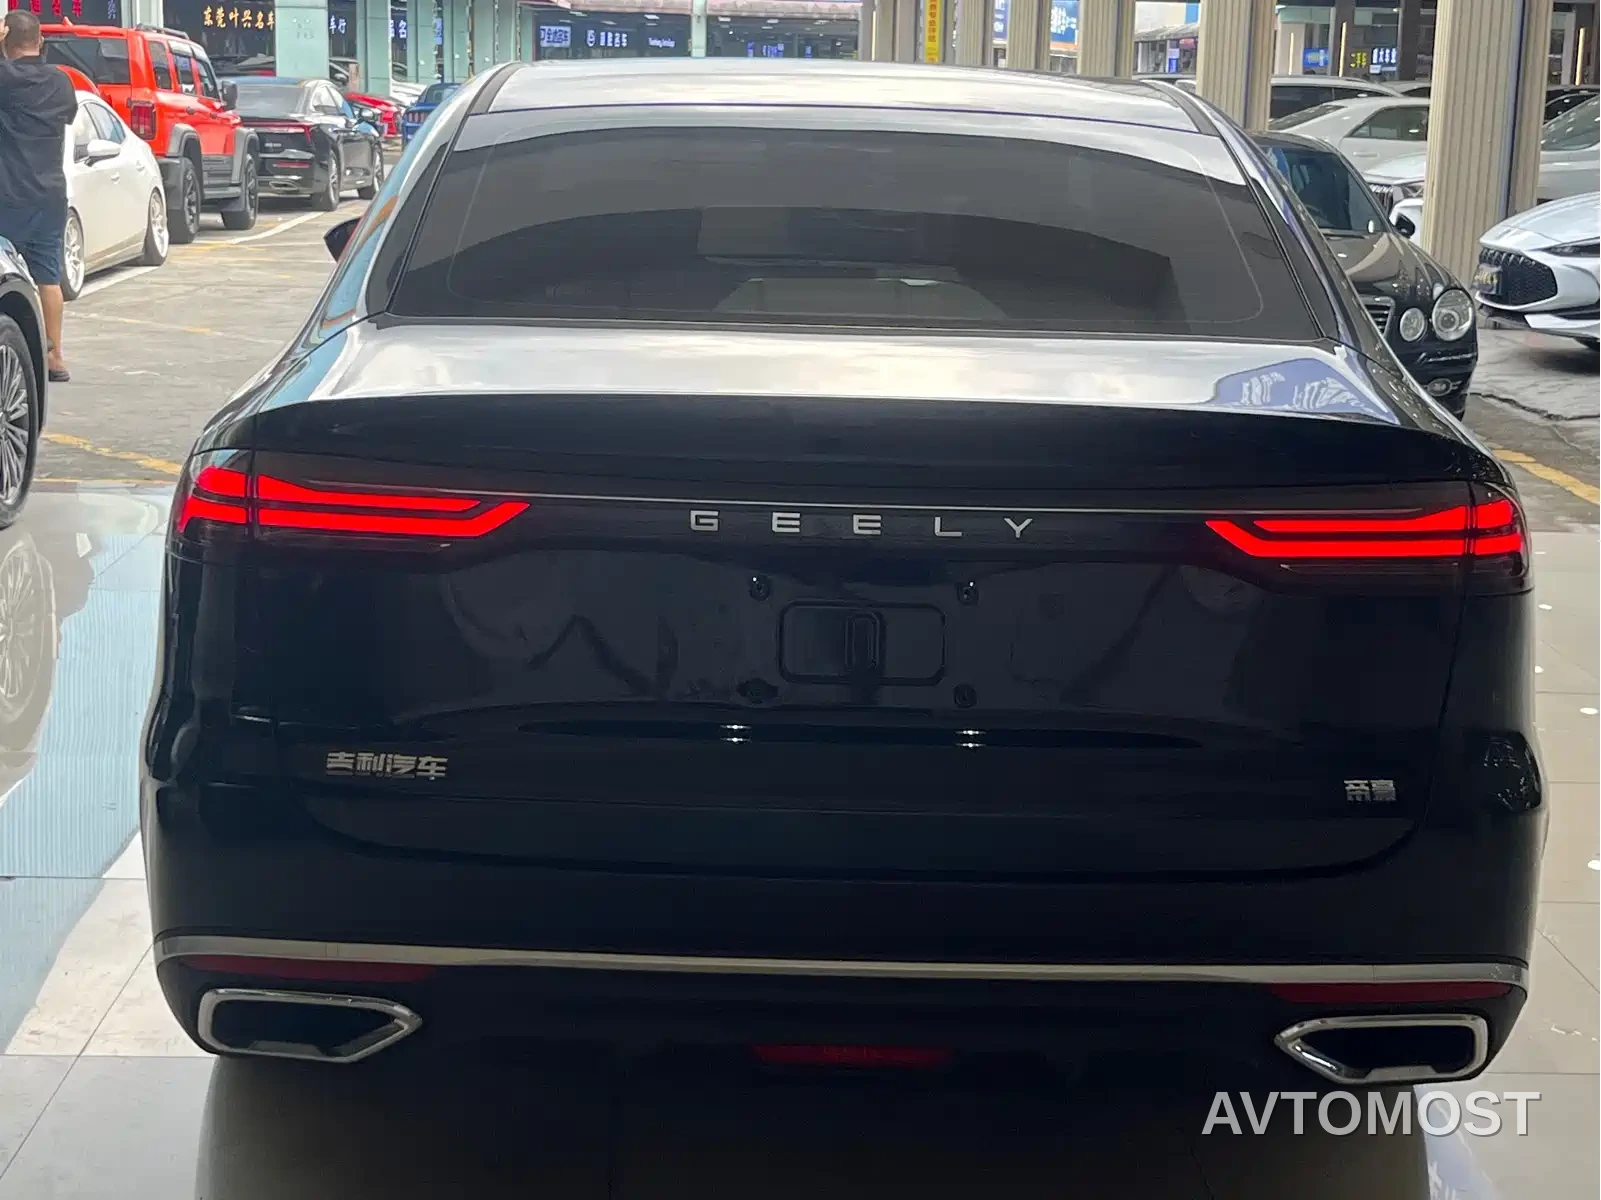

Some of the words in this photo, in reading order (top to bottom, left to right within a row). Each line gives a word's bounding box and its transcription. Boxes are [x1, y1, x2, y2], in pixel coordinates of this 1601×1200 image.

[690, 509, 1033, 538] GEELY
[326, 751, 449, 780] 吉利汽车
